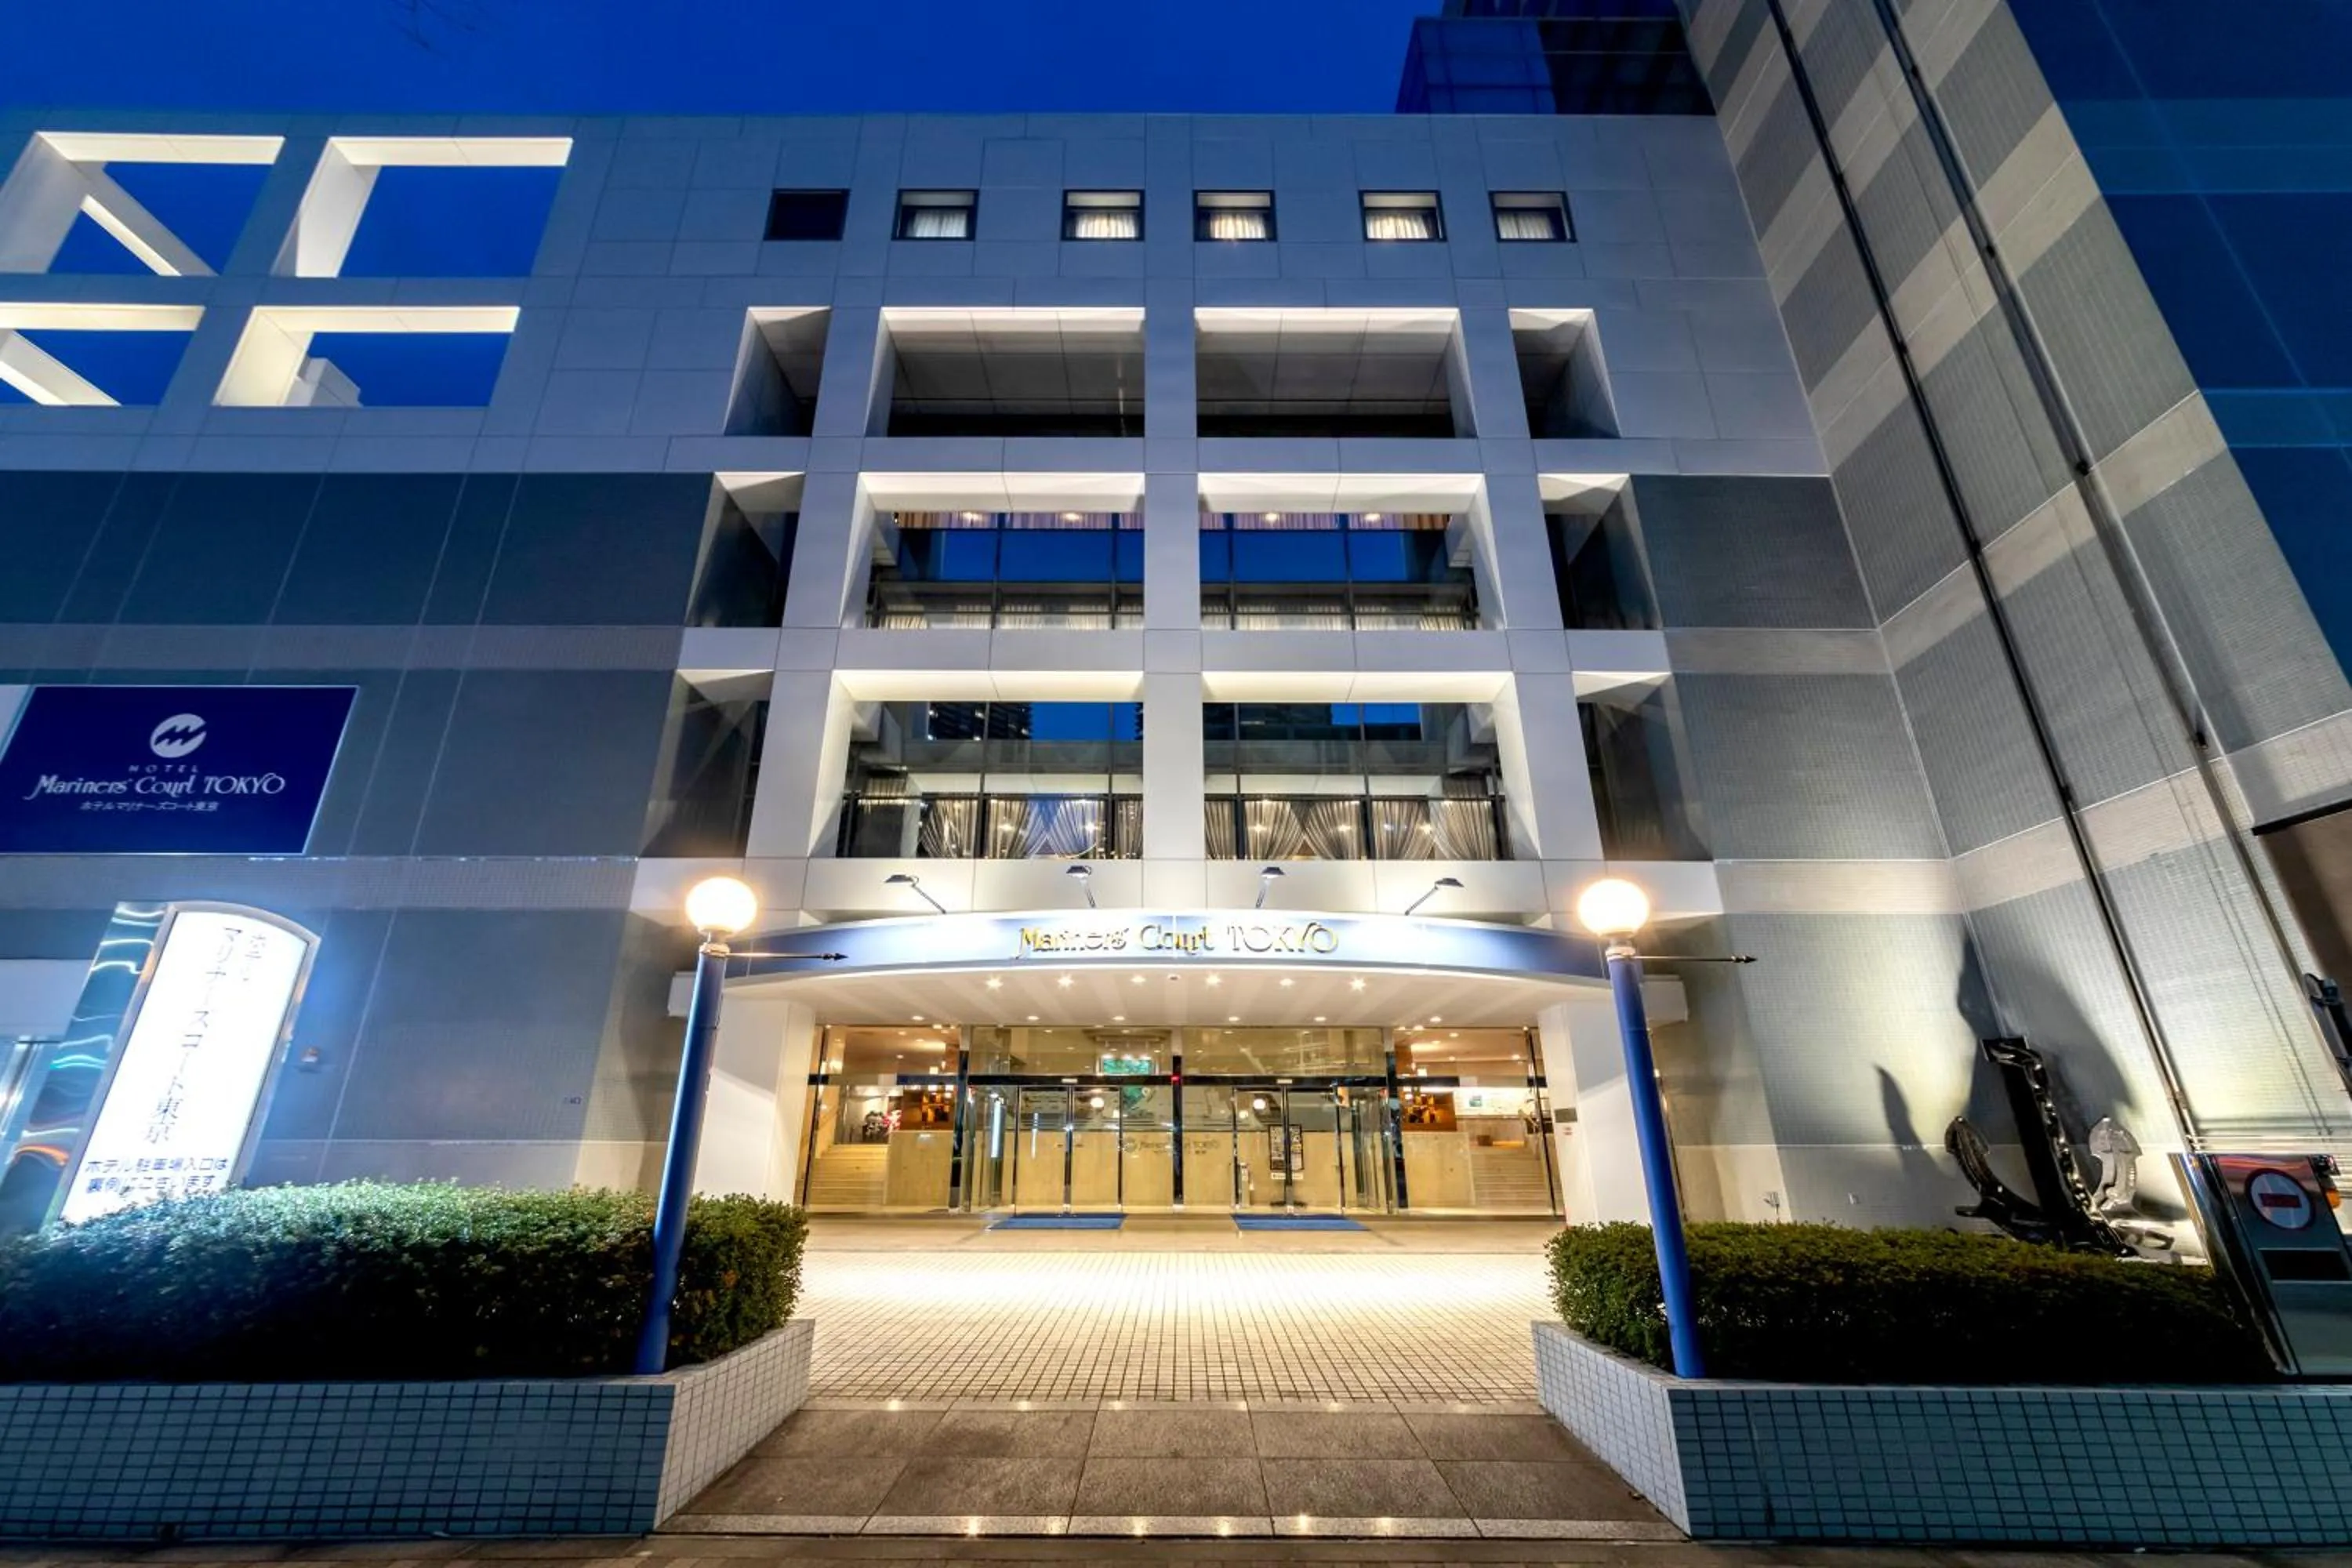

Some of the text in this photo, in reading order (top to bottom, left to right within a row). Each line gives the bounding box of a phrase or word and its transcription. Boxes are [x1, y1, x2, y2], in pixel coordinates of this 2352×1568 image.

[128, 764, 198, 773] HOTEL
[203, 772, 285, 794] TOKYO
[1227, 922, 1338, 953] TOKYO
